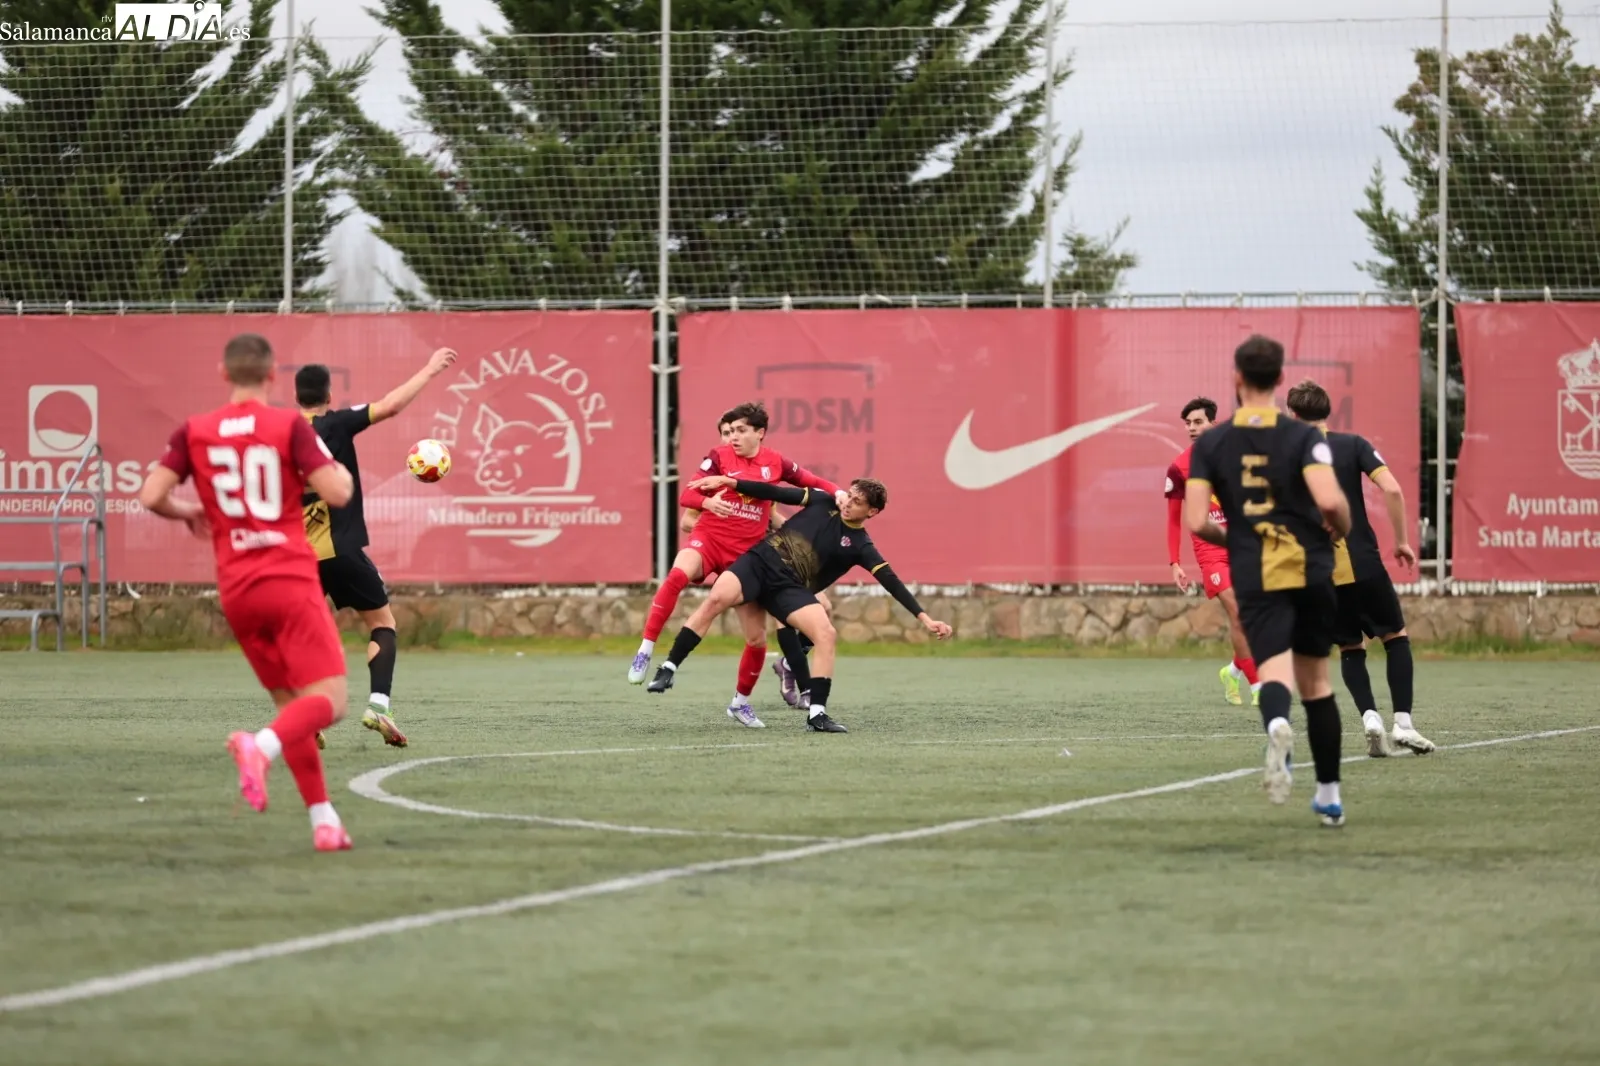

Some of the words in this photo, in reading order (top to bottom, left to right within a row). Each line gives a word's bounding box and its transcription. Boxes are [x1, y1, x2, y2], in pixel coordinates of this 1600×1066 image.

[0, 450, 160, 493] imcas
[206, 444, 283, 521] 20
[1241, 454, 1276, 516] 5
[62, 498, 146, 514] PROESIO
[427, 506, 517, 526] Matadero
[1506, 492, 1599, 521] Ayuntam
[1478, 525, 1537, 549] Santa
[1542, 525, 1600, 549] Marta
